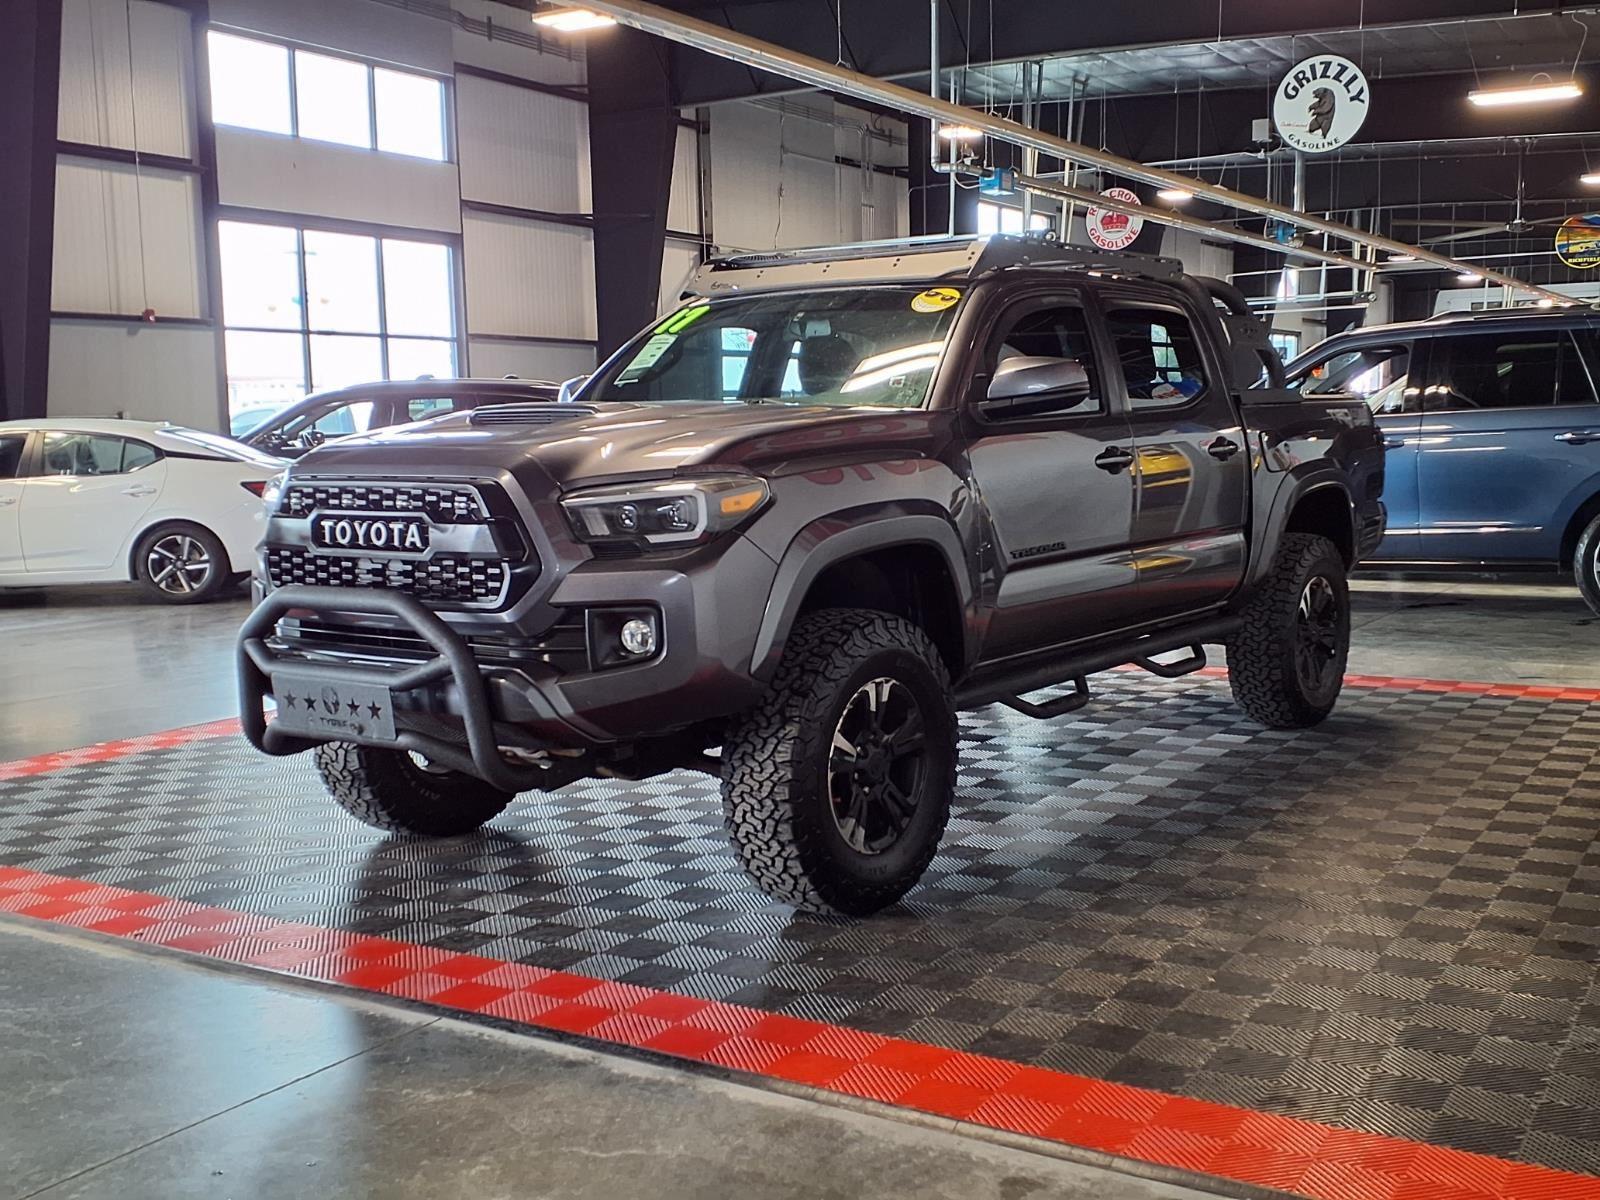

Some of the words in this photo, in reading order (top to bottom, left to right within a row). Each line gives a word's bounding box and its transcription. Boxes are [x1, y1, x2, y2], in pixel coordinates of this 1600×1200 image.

[1284, 61, 1365, 104] GRIZZLY
[1288, 133, 1341, 150] GASOLINE
[1109, 190, 1139, 205] CROW
[1089, 227, 1138, 249] GASOLINE
[320, 519, 425, 550] TOYOTA
